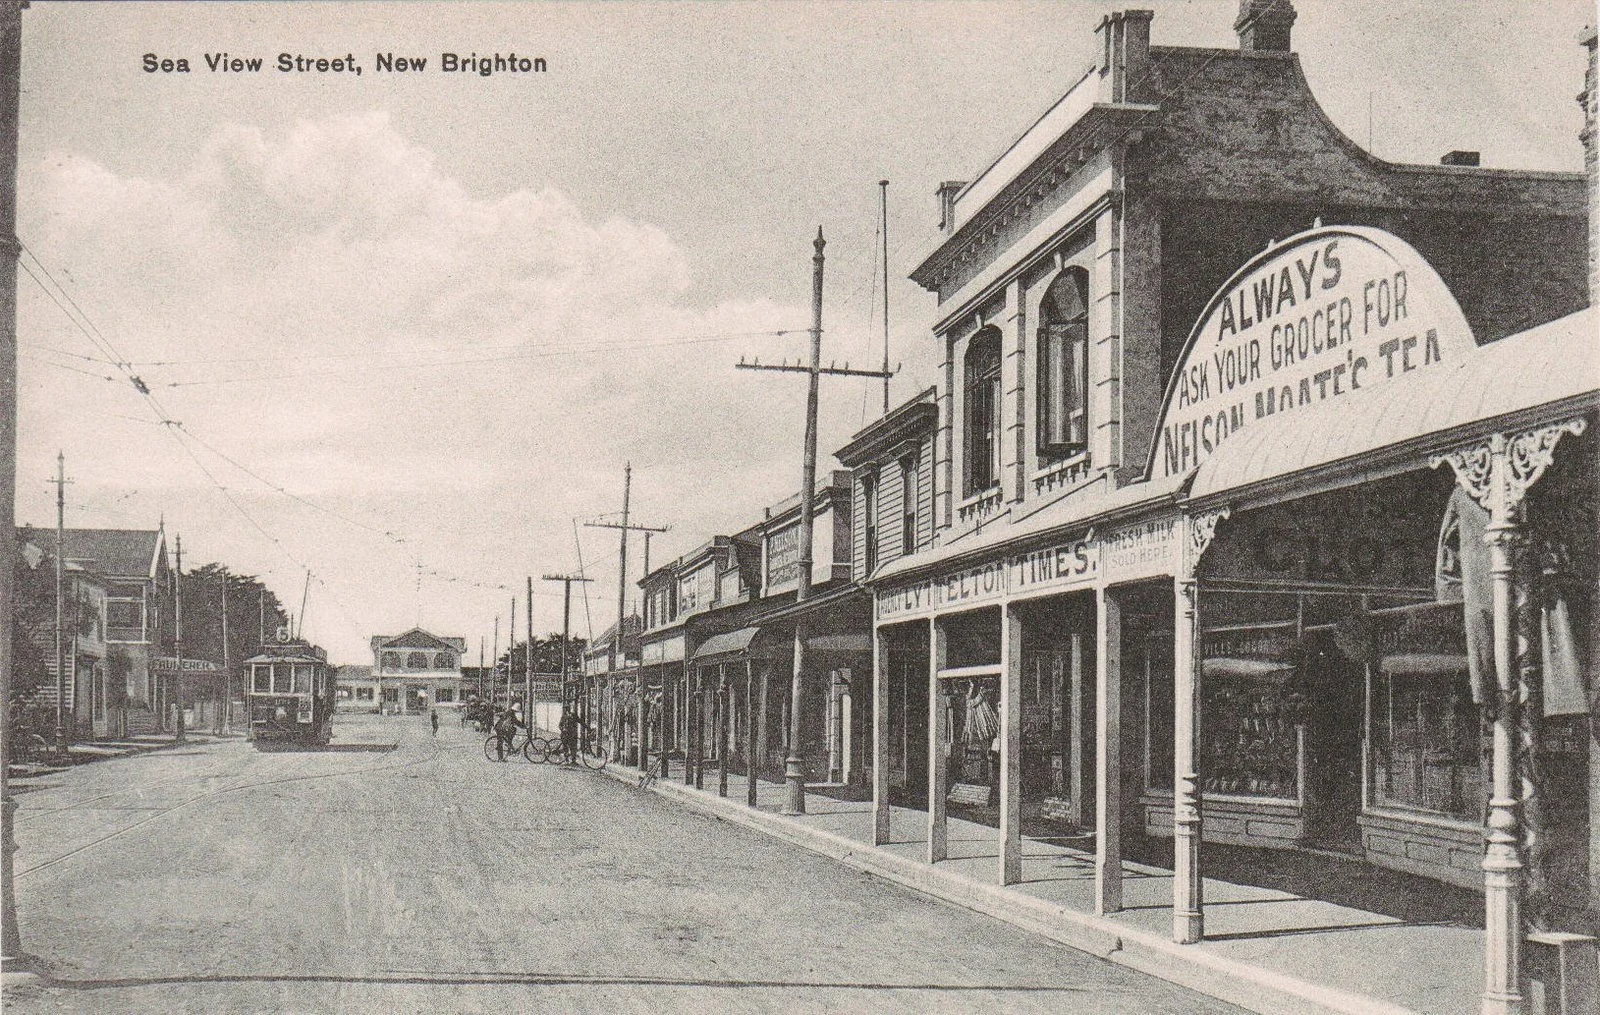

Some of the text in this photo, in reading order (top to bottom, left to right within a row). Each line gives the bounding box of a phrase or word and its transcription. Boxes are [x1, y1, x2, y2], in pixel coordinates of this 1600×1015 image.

[1217, 240, 1342, 342] ALWAYS
[1178, 270, 1408, 410] ASK YOUR GROCER FOR
[1379, 328, 1442, 378] TEA
[1147, 519, 1175, 545] MILK
[1017, 541, 1097, 586] TIMES.
[1111, 552, 1136, 568] SOLD
